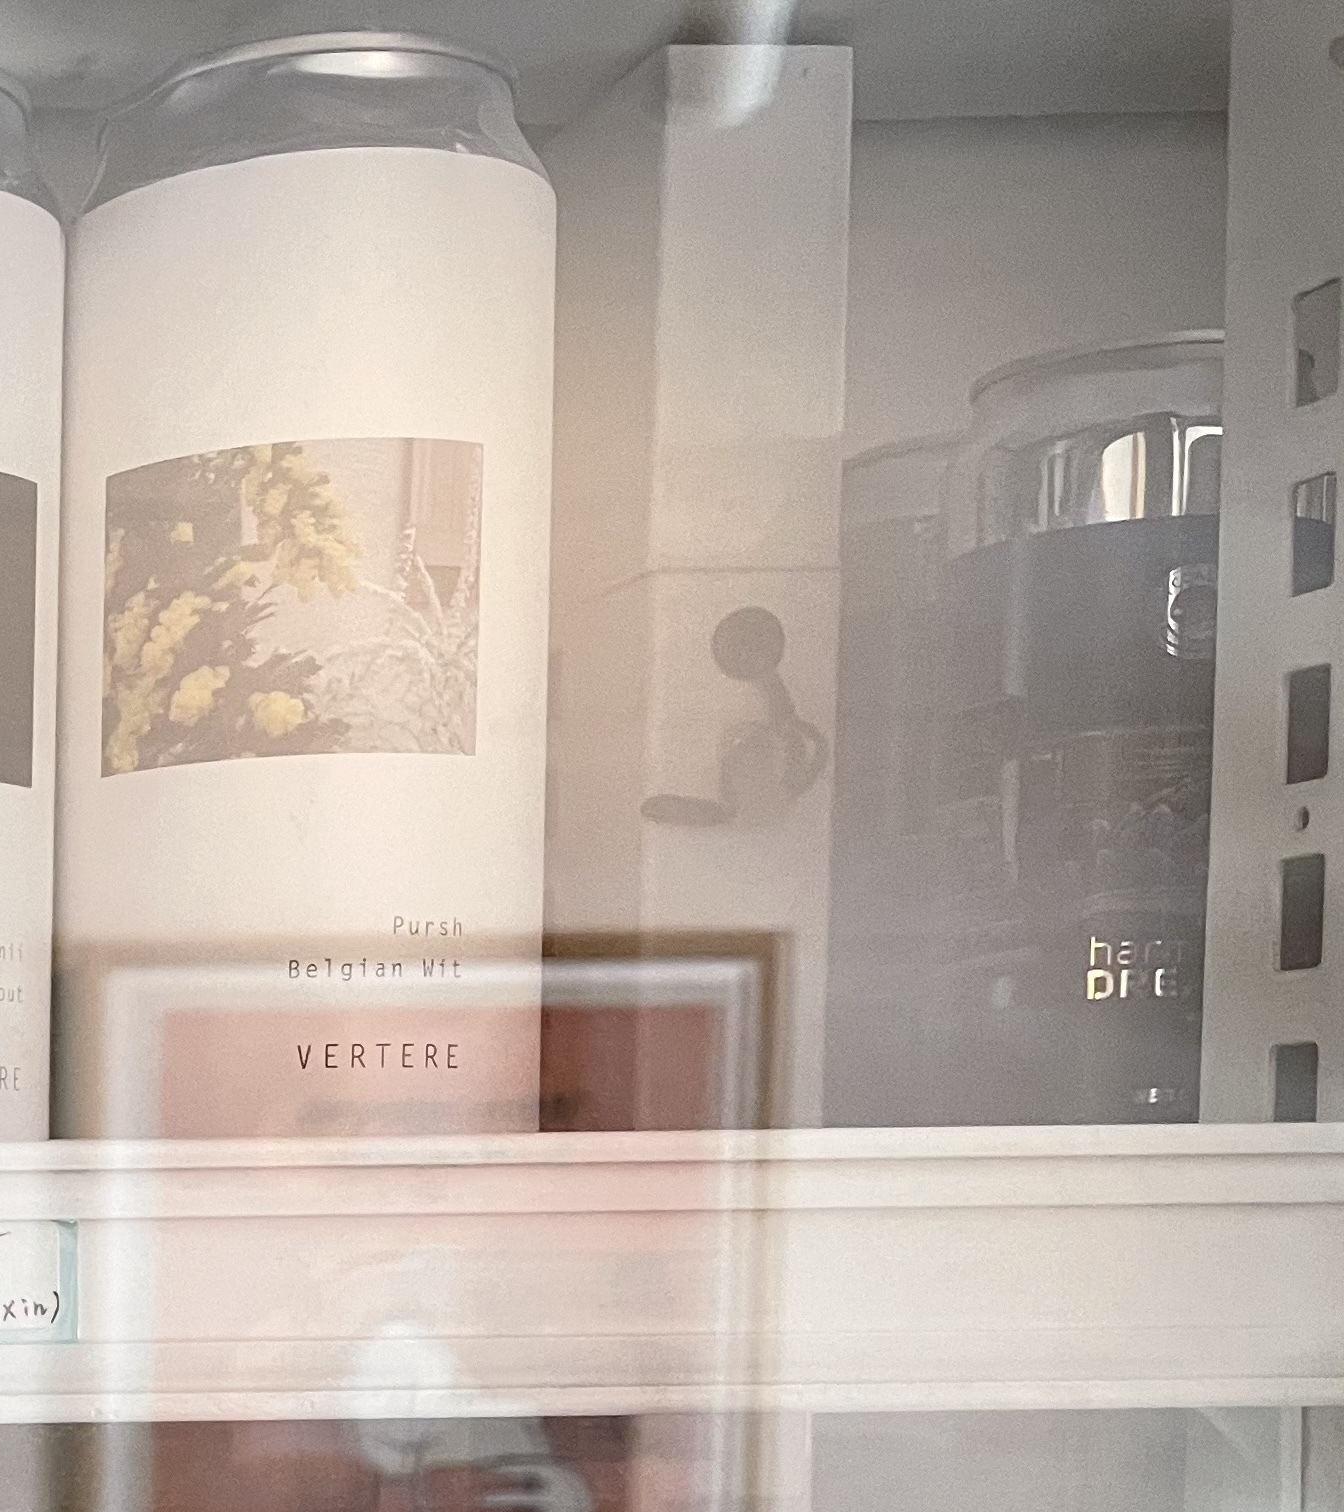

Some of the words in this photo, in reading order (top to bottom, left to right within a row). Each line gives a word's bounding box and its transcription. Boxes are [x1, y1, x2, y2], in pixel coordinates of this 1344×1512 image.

[393, 916, 463, 938] Pursh
[288, 958, 403, 982] Belgian
[422, 958, 463, 980] Wit
[297, 1043, 461, 1071] VERTERE
